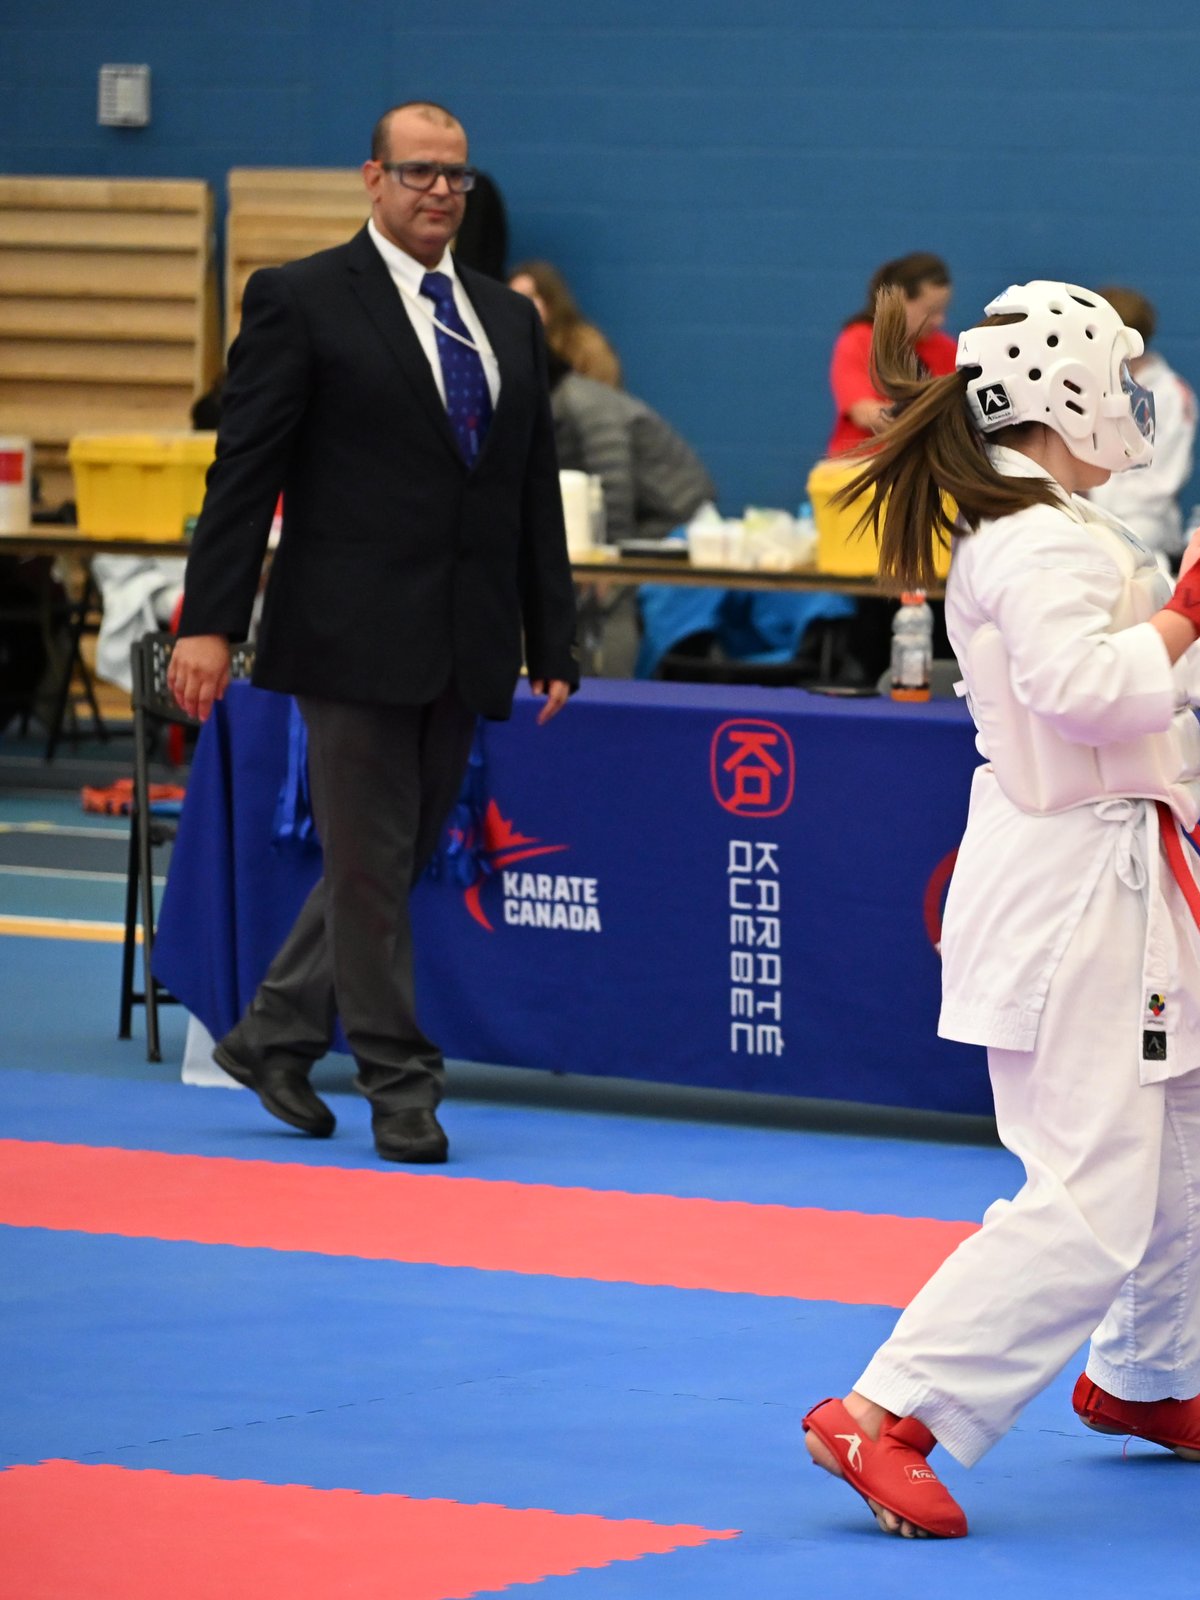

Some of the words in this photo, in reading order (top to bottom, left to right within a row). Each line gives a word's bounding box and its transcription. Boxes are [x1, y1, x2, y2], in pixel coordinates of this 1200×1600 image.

[503, 871, 598, 904] KARATE
[504, 899, 601, 932] CANADA
[727, 840, 756, 1054] QUÉBEC
[755, 842, 784, 1056] KARATÉ
